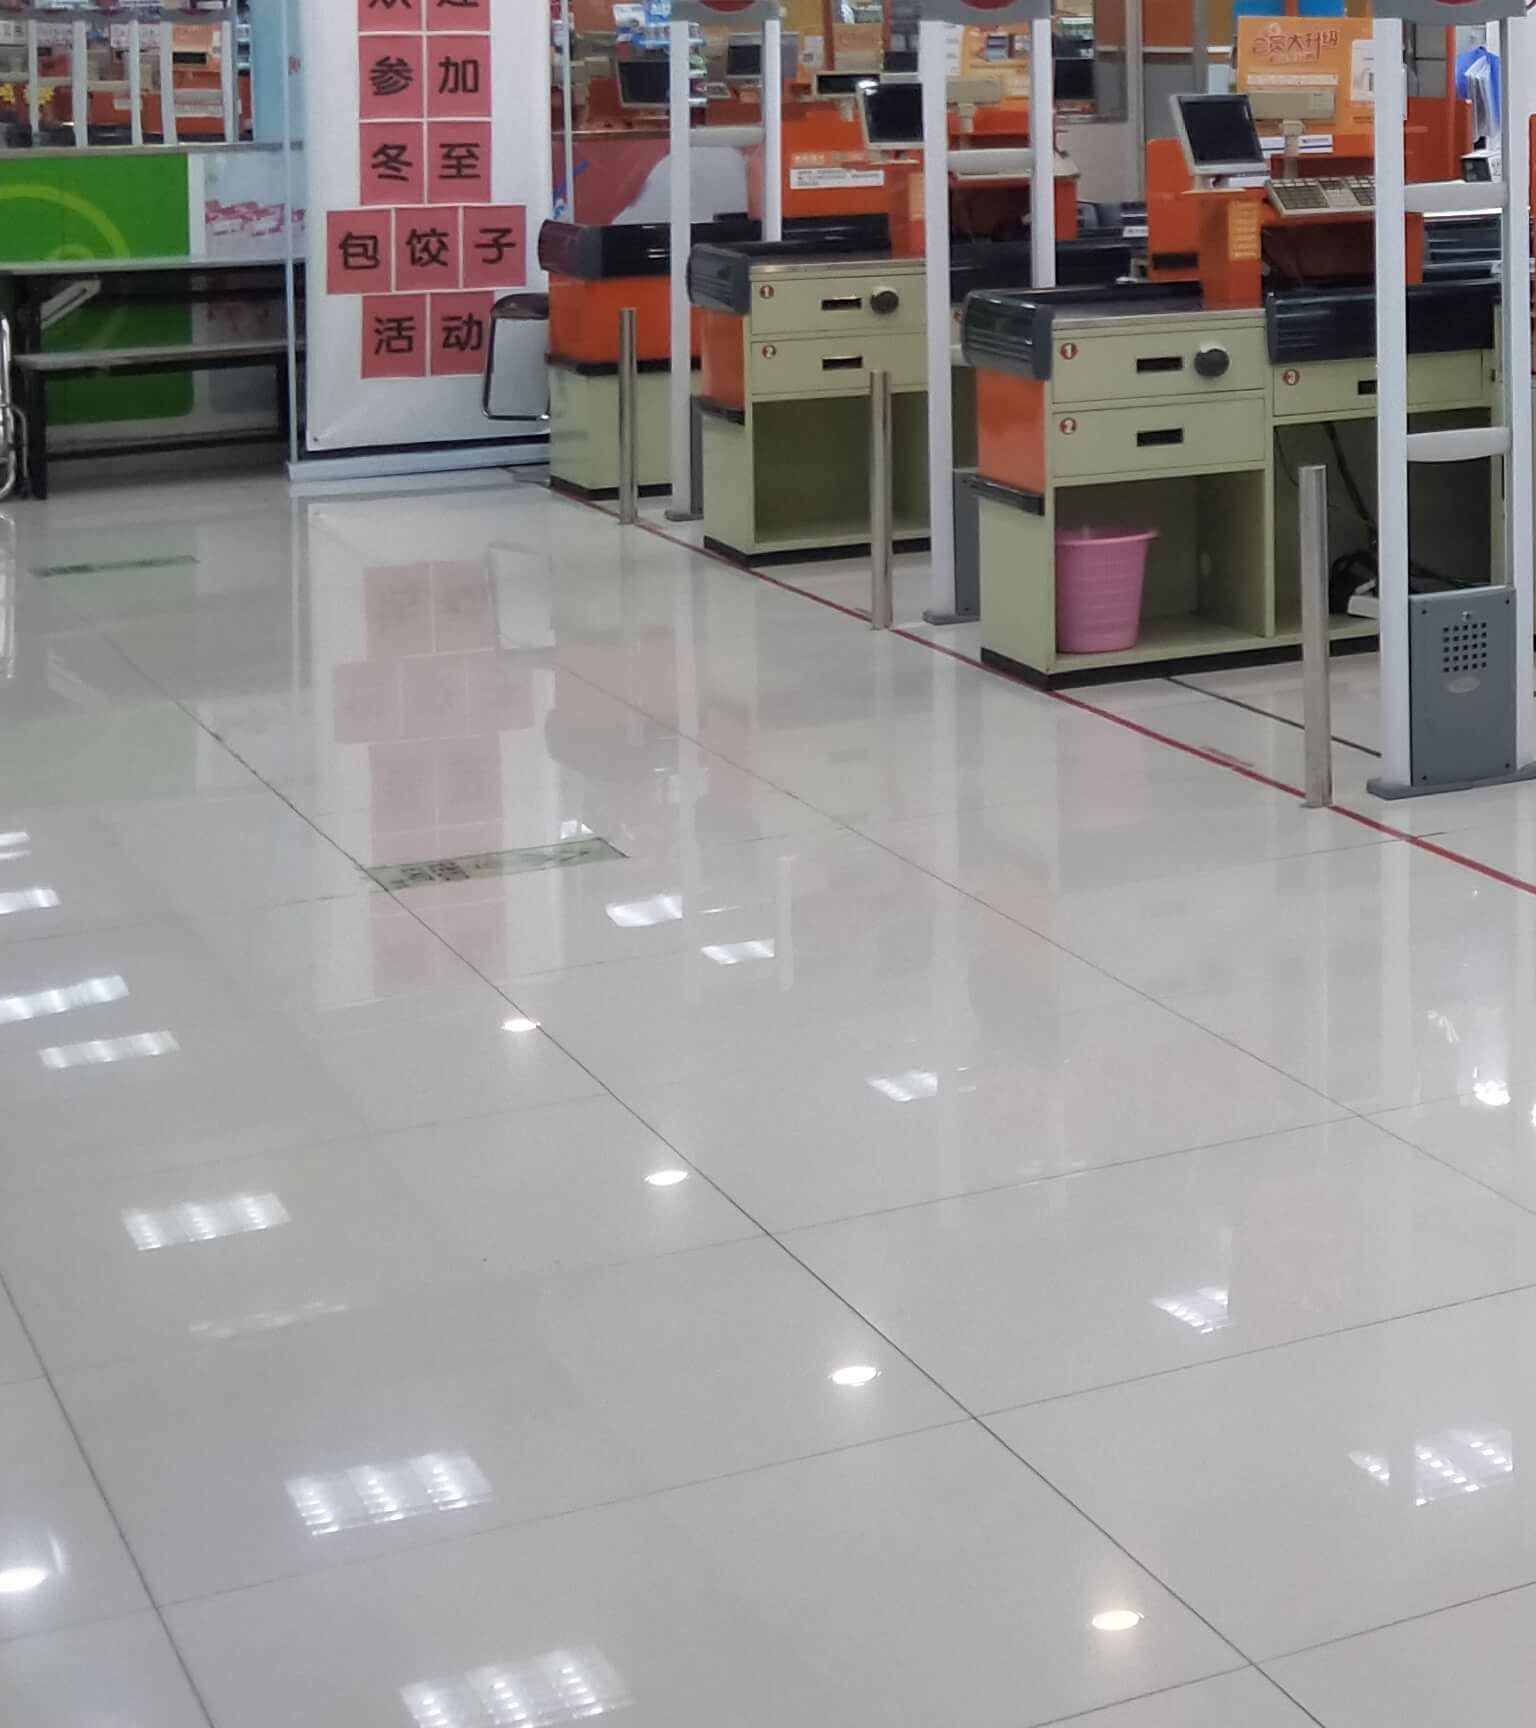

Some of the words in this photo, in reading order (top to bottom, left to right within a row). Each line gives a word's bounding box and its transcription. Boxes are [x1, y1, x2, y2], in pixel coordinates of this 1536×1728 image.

[371, 56, 480, 98] 参加
[372, 143, 481, 184] 冬至
[339, 227, 518, 270] 包饺子
[374, 313, 483, 355] 活动
